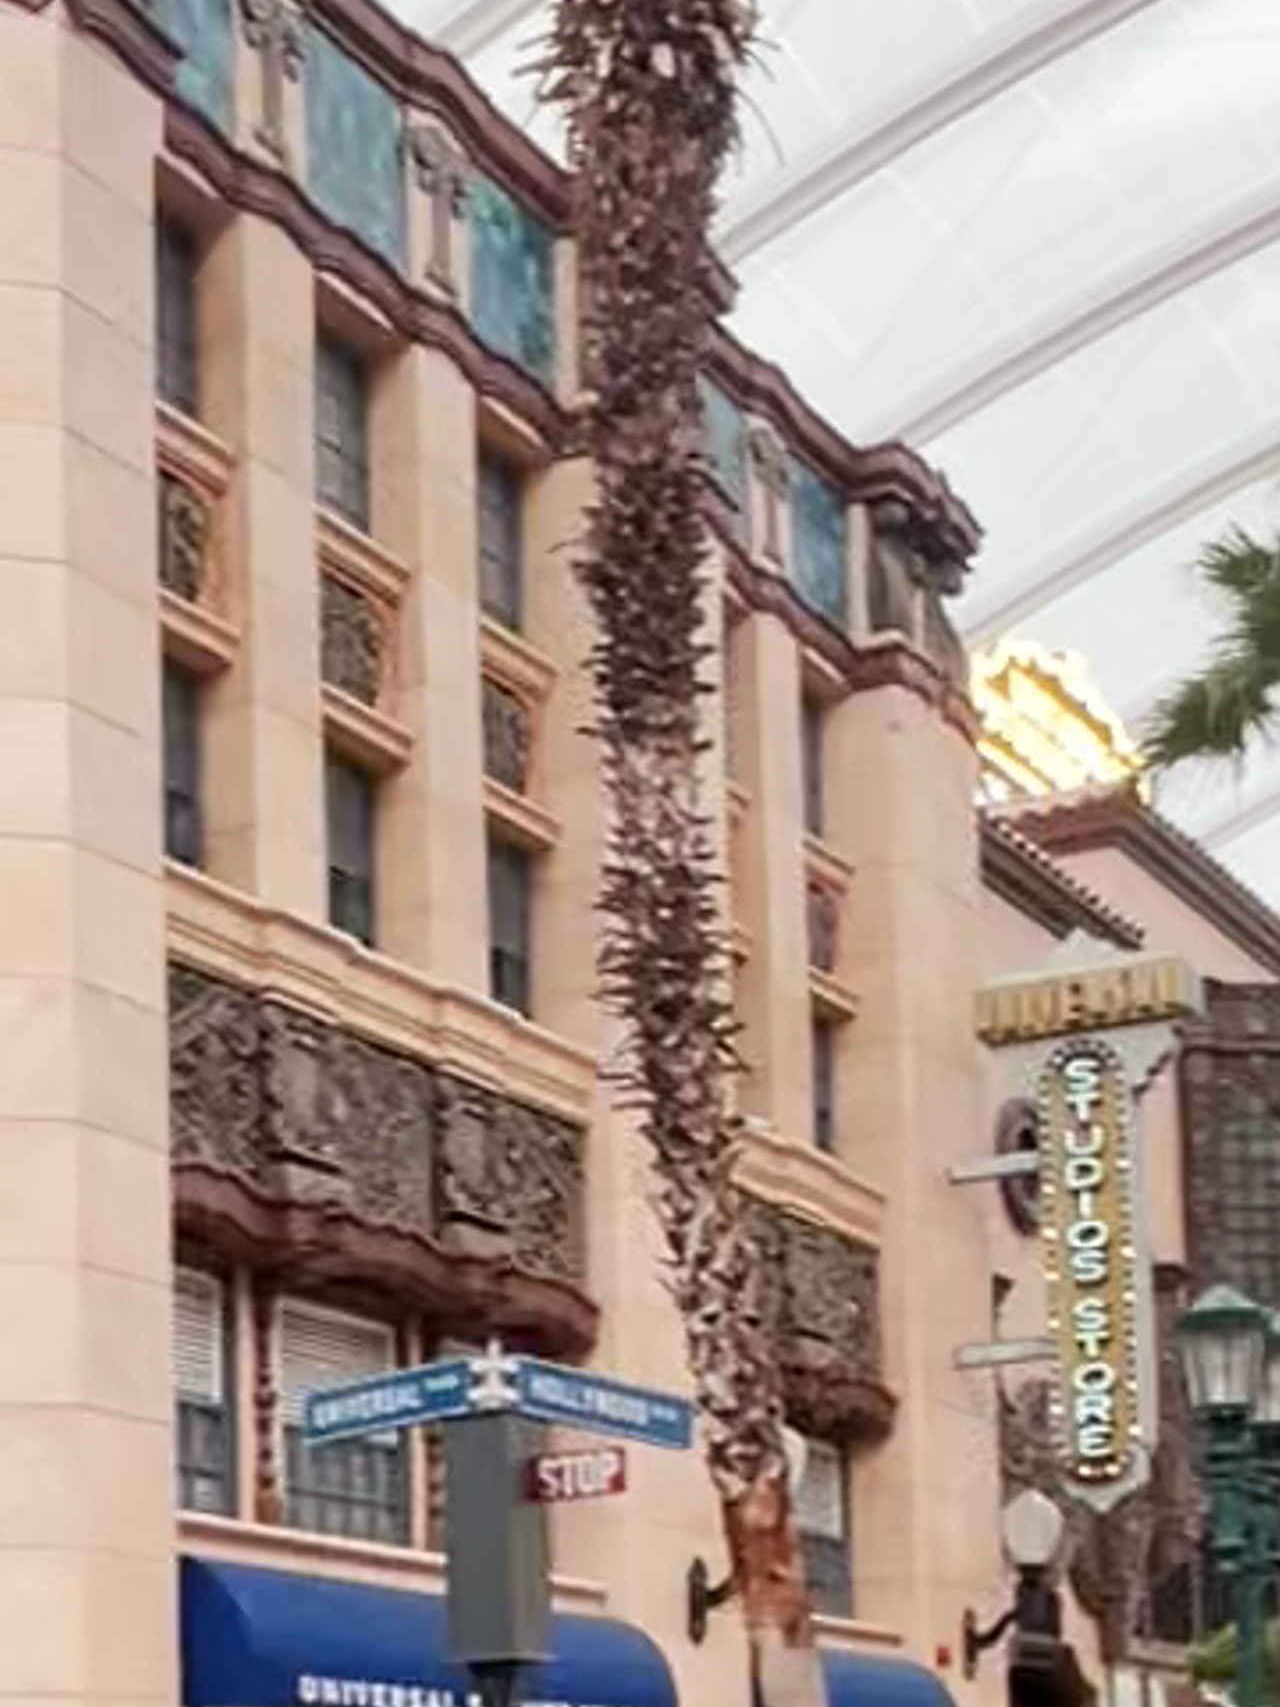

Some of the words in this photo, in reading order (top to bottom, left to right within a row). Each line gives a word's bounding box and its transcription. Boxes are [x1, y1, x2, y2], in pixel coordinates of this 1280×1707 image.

[1063, 1058, 1109, 1283] STUDIOS
[1072, 1298, 1116, 1457] STORE
[538, 1451, 619, 1497] STOP
